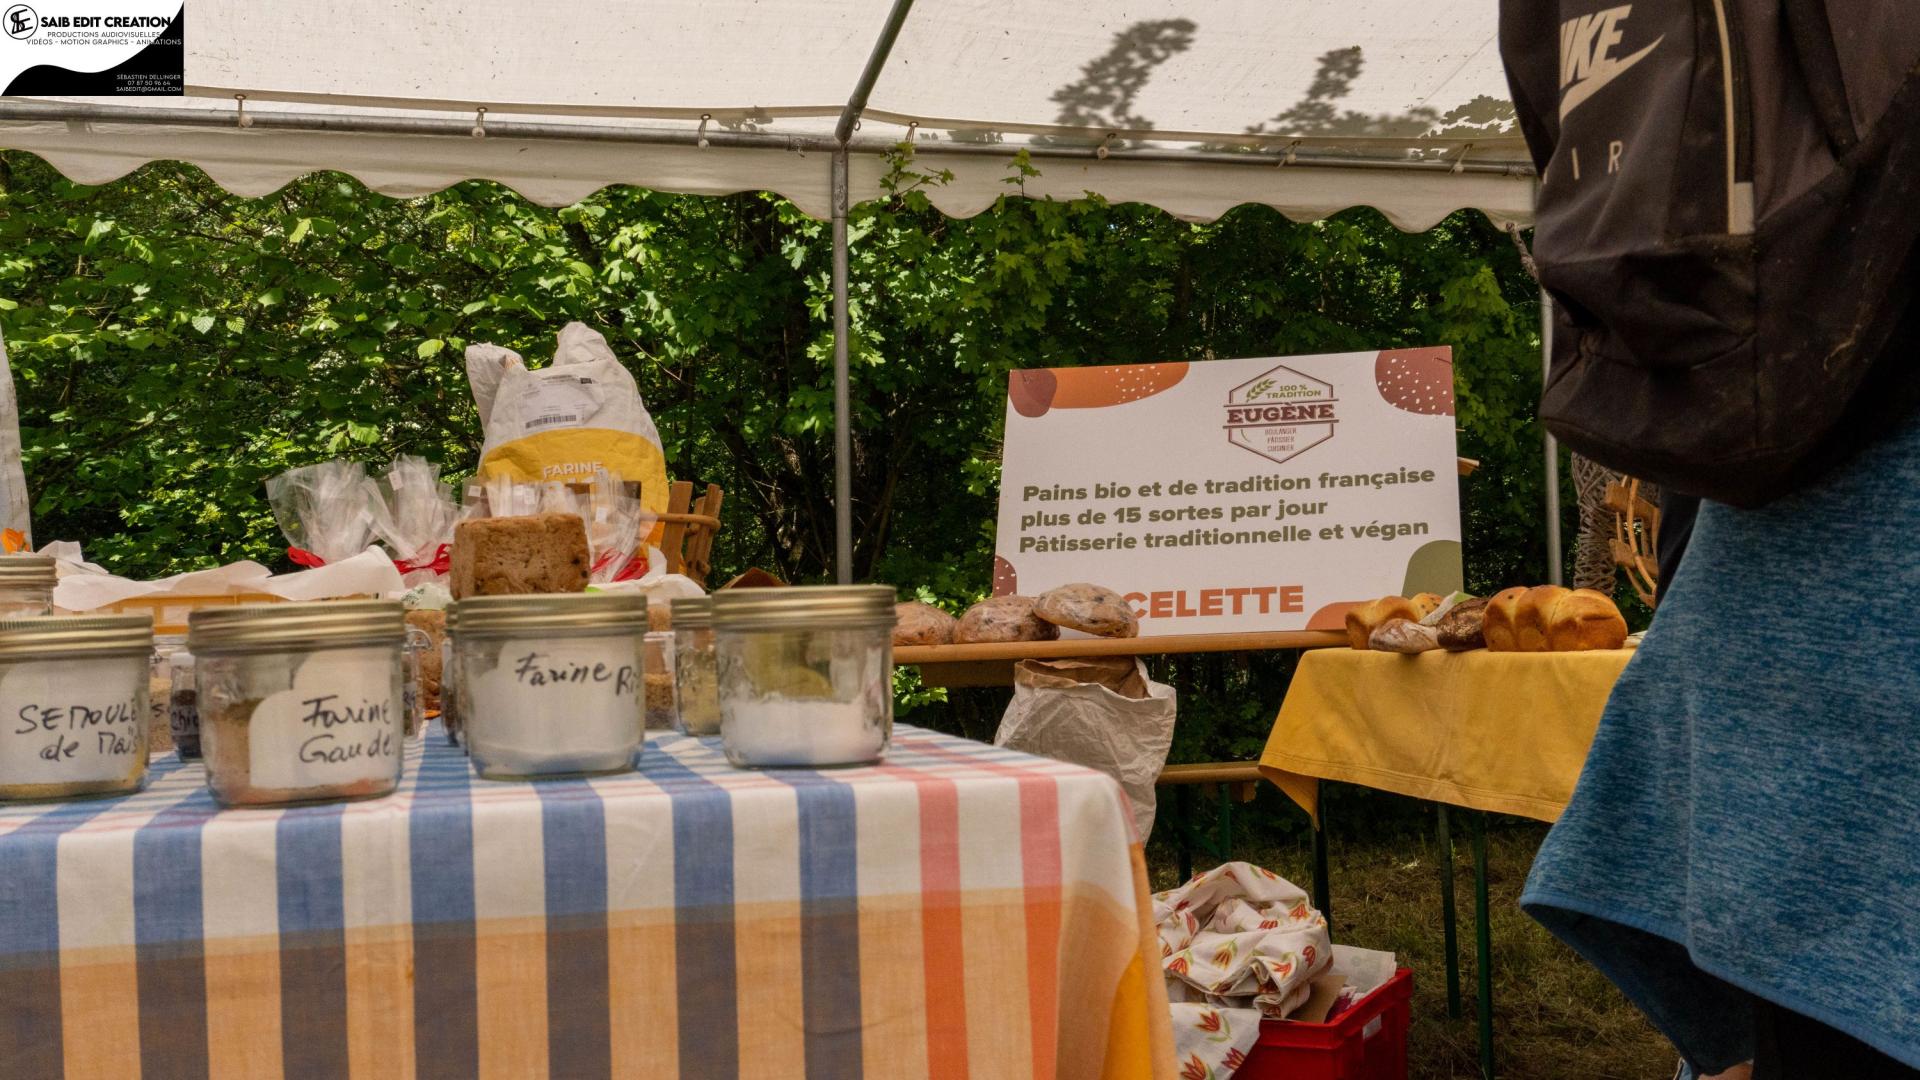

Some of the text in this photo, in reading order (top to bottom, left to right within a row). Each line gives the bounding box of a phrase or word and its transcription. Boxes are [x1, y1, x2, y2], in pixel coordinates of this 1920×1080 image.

[1543, 139, 1624, 185] IR
[1265, 390, 1322, 399] TRADITION
[1226, 401, 1335, 424] EUGÈNE
[543, 461, 604, 479] FARINE
[1023, 467, 1436, 501] Pains bio et de tradition française
[1021, 499, 1329, 531] plus de 15 sortes par jour
[1019, 520, 1429, 553] Pâtisserie traditionnelle et végan
[514, 652, 612, 687] Farine
[301, 694, 392, 729] Farine
[39, 734, 80, 762] de
